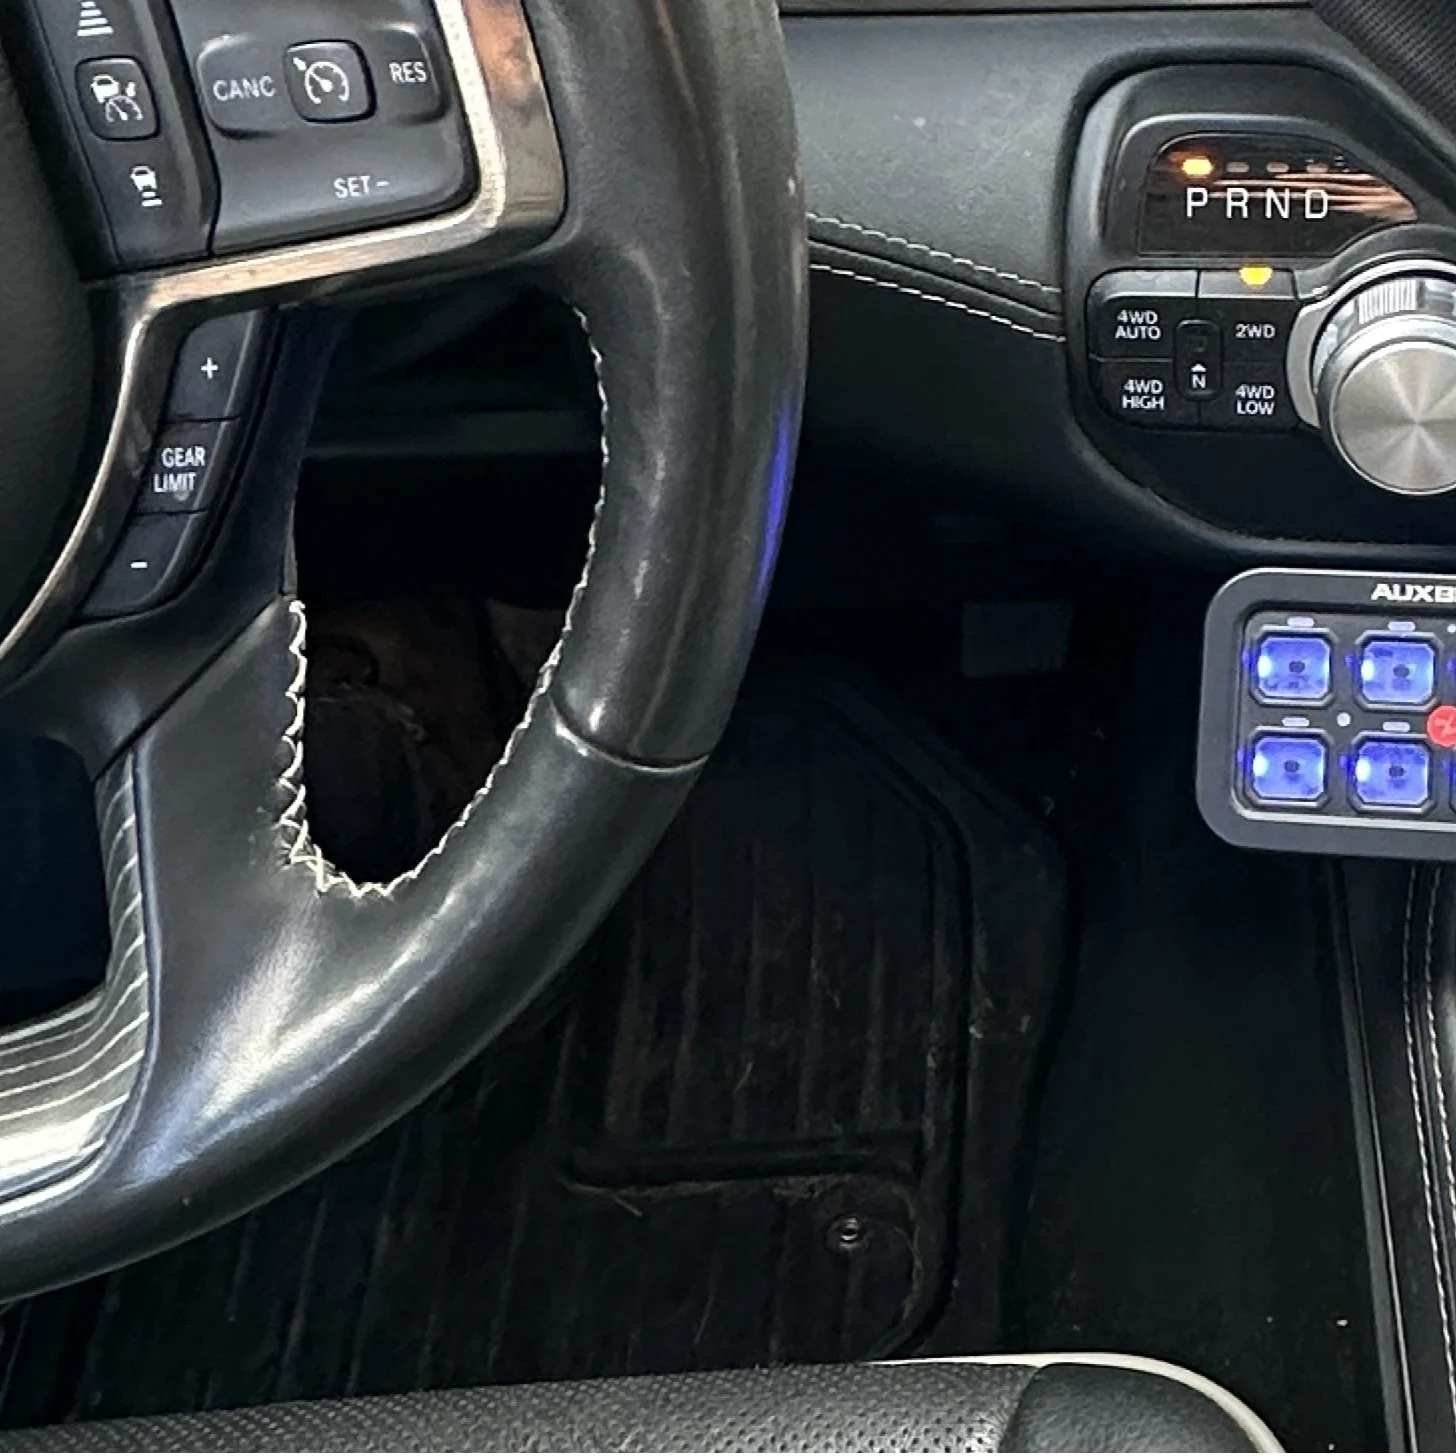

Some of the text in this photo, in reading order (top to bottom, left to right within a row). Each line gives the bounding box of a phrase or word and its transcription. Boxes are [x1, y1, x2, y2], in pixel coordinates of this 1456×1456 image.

[388, 60, 425, 84] RES
[213, 75, 276, 101] CANC
[1116, 309, 1158, 326] 4WD
[1114, 325, 1162, 341] AUTO
[1234, 323, 1277, 340] 2WD
[1123, 378, 1164, 396] 4WD
[1235, 383, 1276, 400] 4WD
[1121, 394, 1165, 412] HIGH
[1235, 399, 1276, 416] LOW
[161, 446, 206, 468] GEAR
[153, 472, 197, 494] LIMIT
